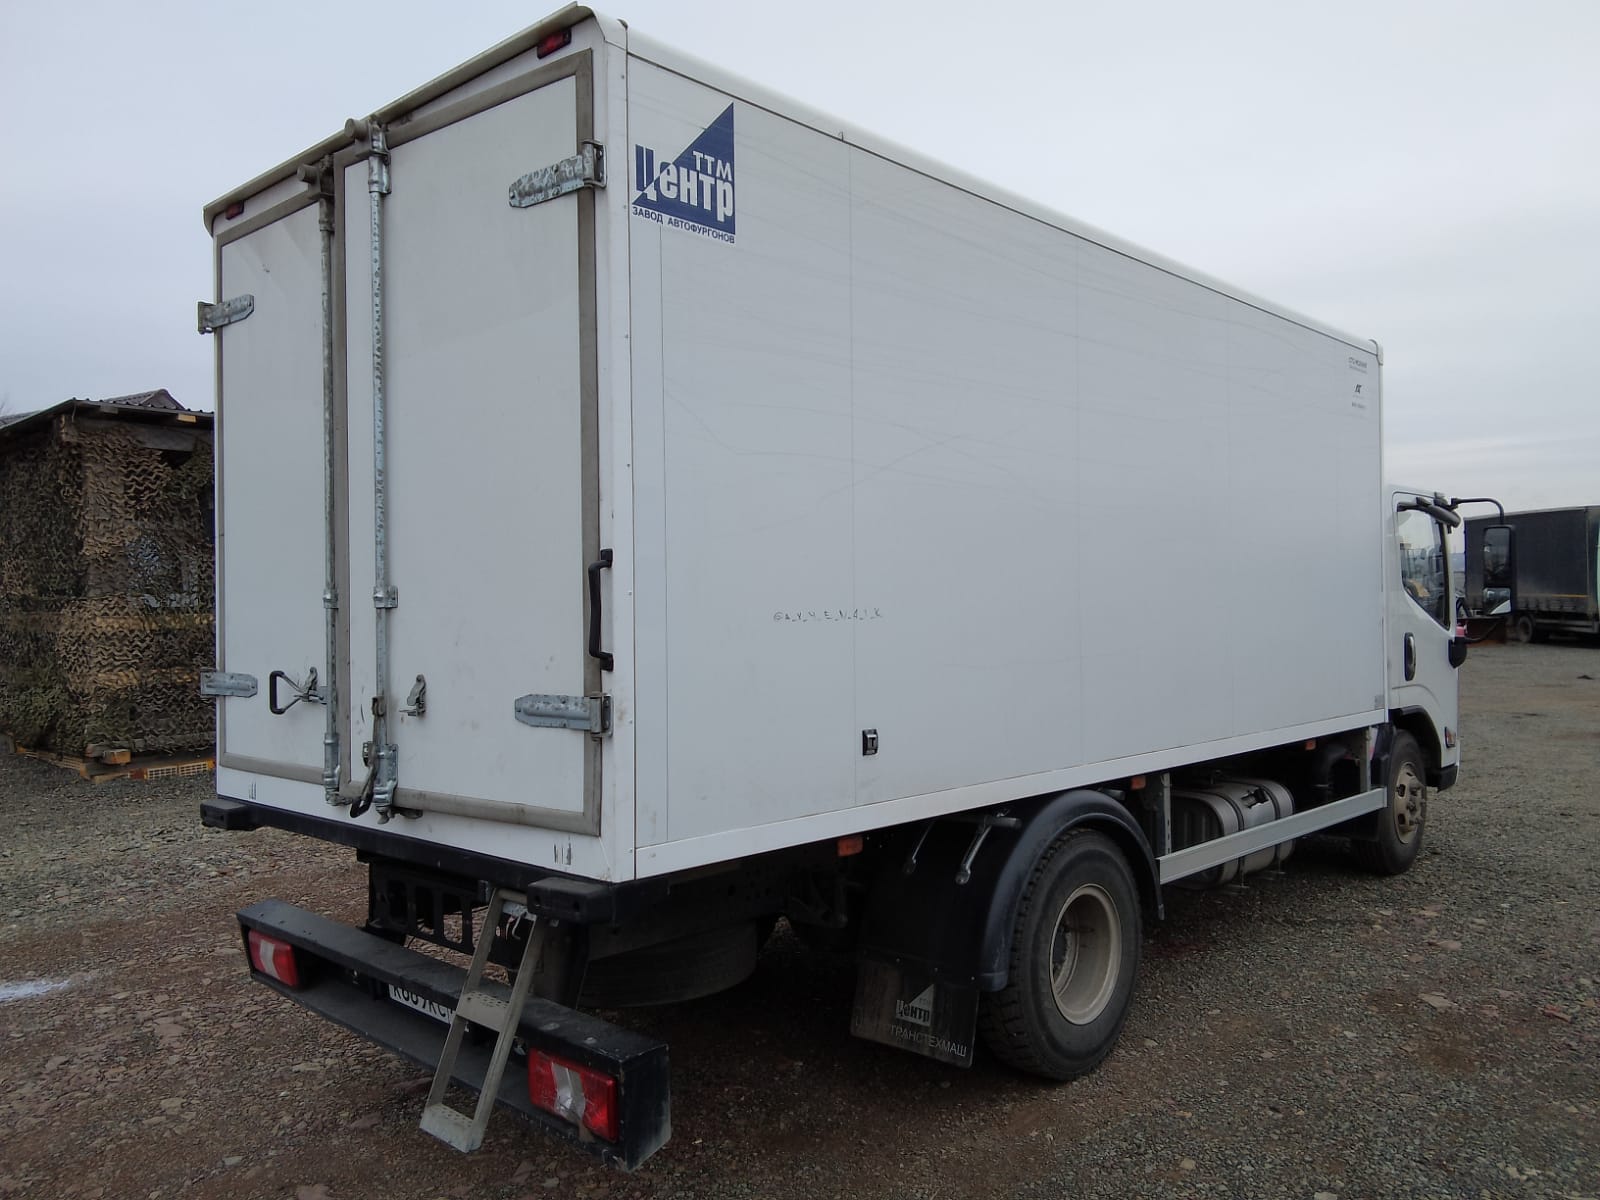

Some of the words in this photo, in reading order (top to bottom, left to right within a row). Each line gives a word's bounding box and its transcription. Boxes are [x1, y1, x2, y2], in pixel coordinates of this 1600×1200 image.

[635, 144, 733, 223] Центр
[692, 150, 732, 181] ТТМ
[632, 206, 664, 225] ЗАВОД
[667, 217, 735, 244] АВТОФУРГОНОВ
